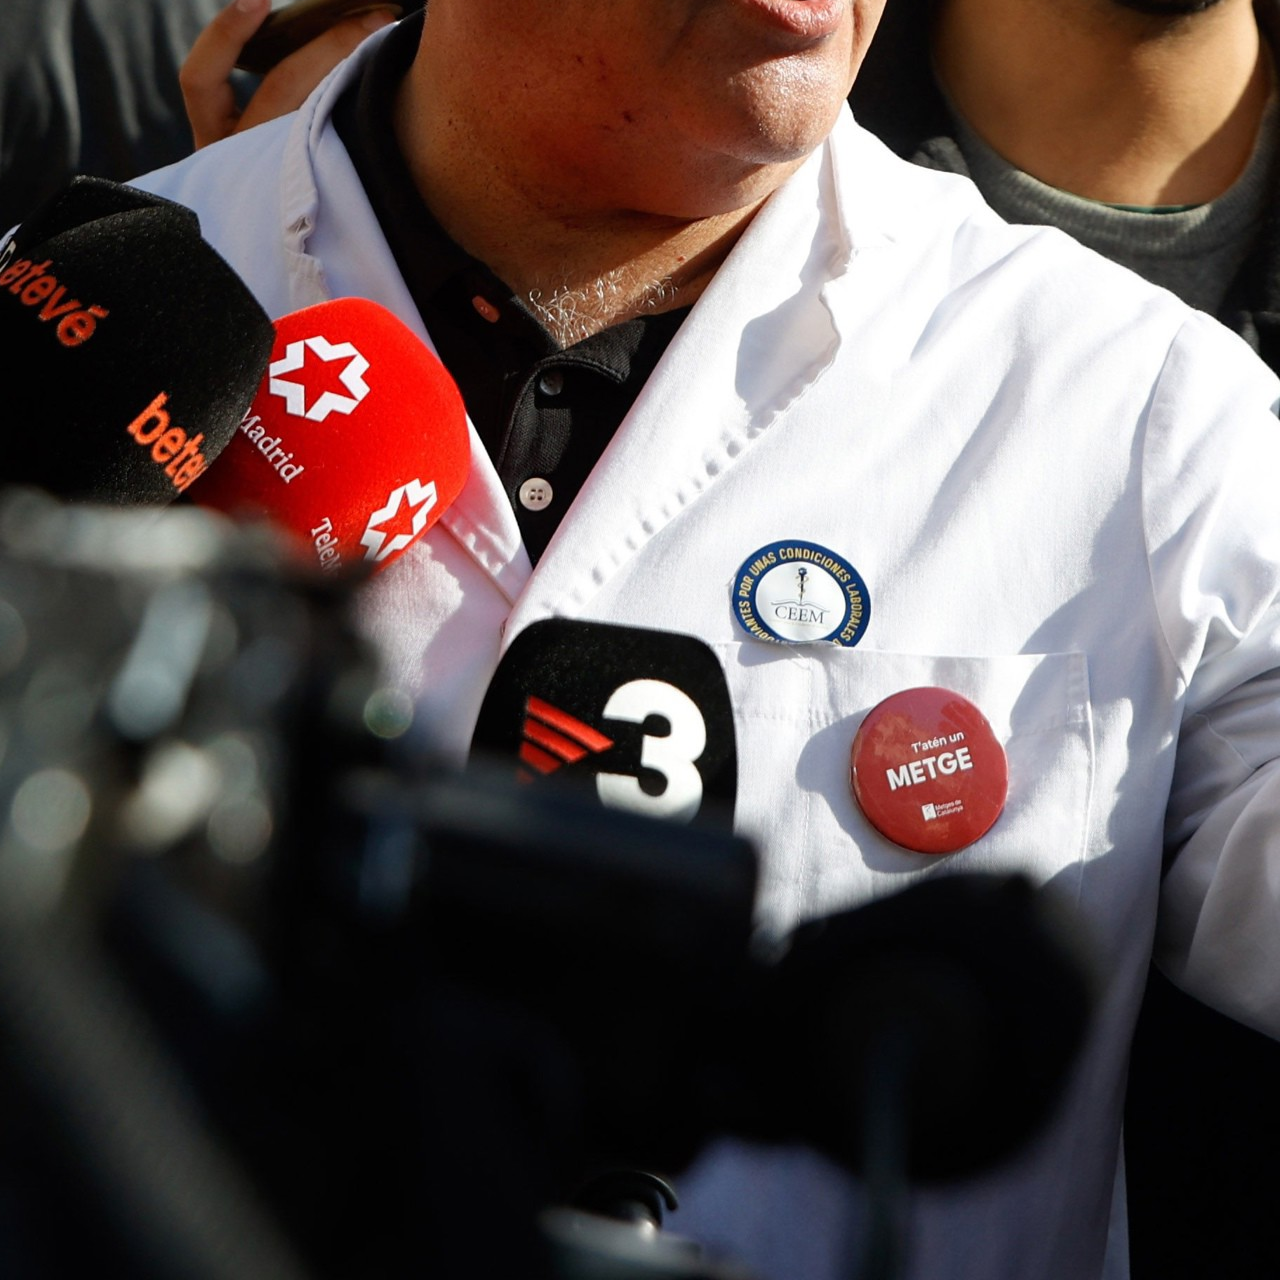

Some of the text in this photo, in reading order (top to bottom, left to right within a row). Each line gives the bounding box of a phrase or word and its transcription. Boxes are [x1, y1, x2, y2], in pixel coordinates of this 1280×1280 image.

[738, 576, 755, 598] POR
[749, 552, 777, 576] UNAS
[779, 547, 851, 583] CONDICIONES
[840, 583, 863, 641] LABORALES
[775, 605, 825, 624] CEEM
[595, 678, 707, 824] 3
[911, 731, 965, 753] T'atén un
[886, 747, 973, 791] METGE
